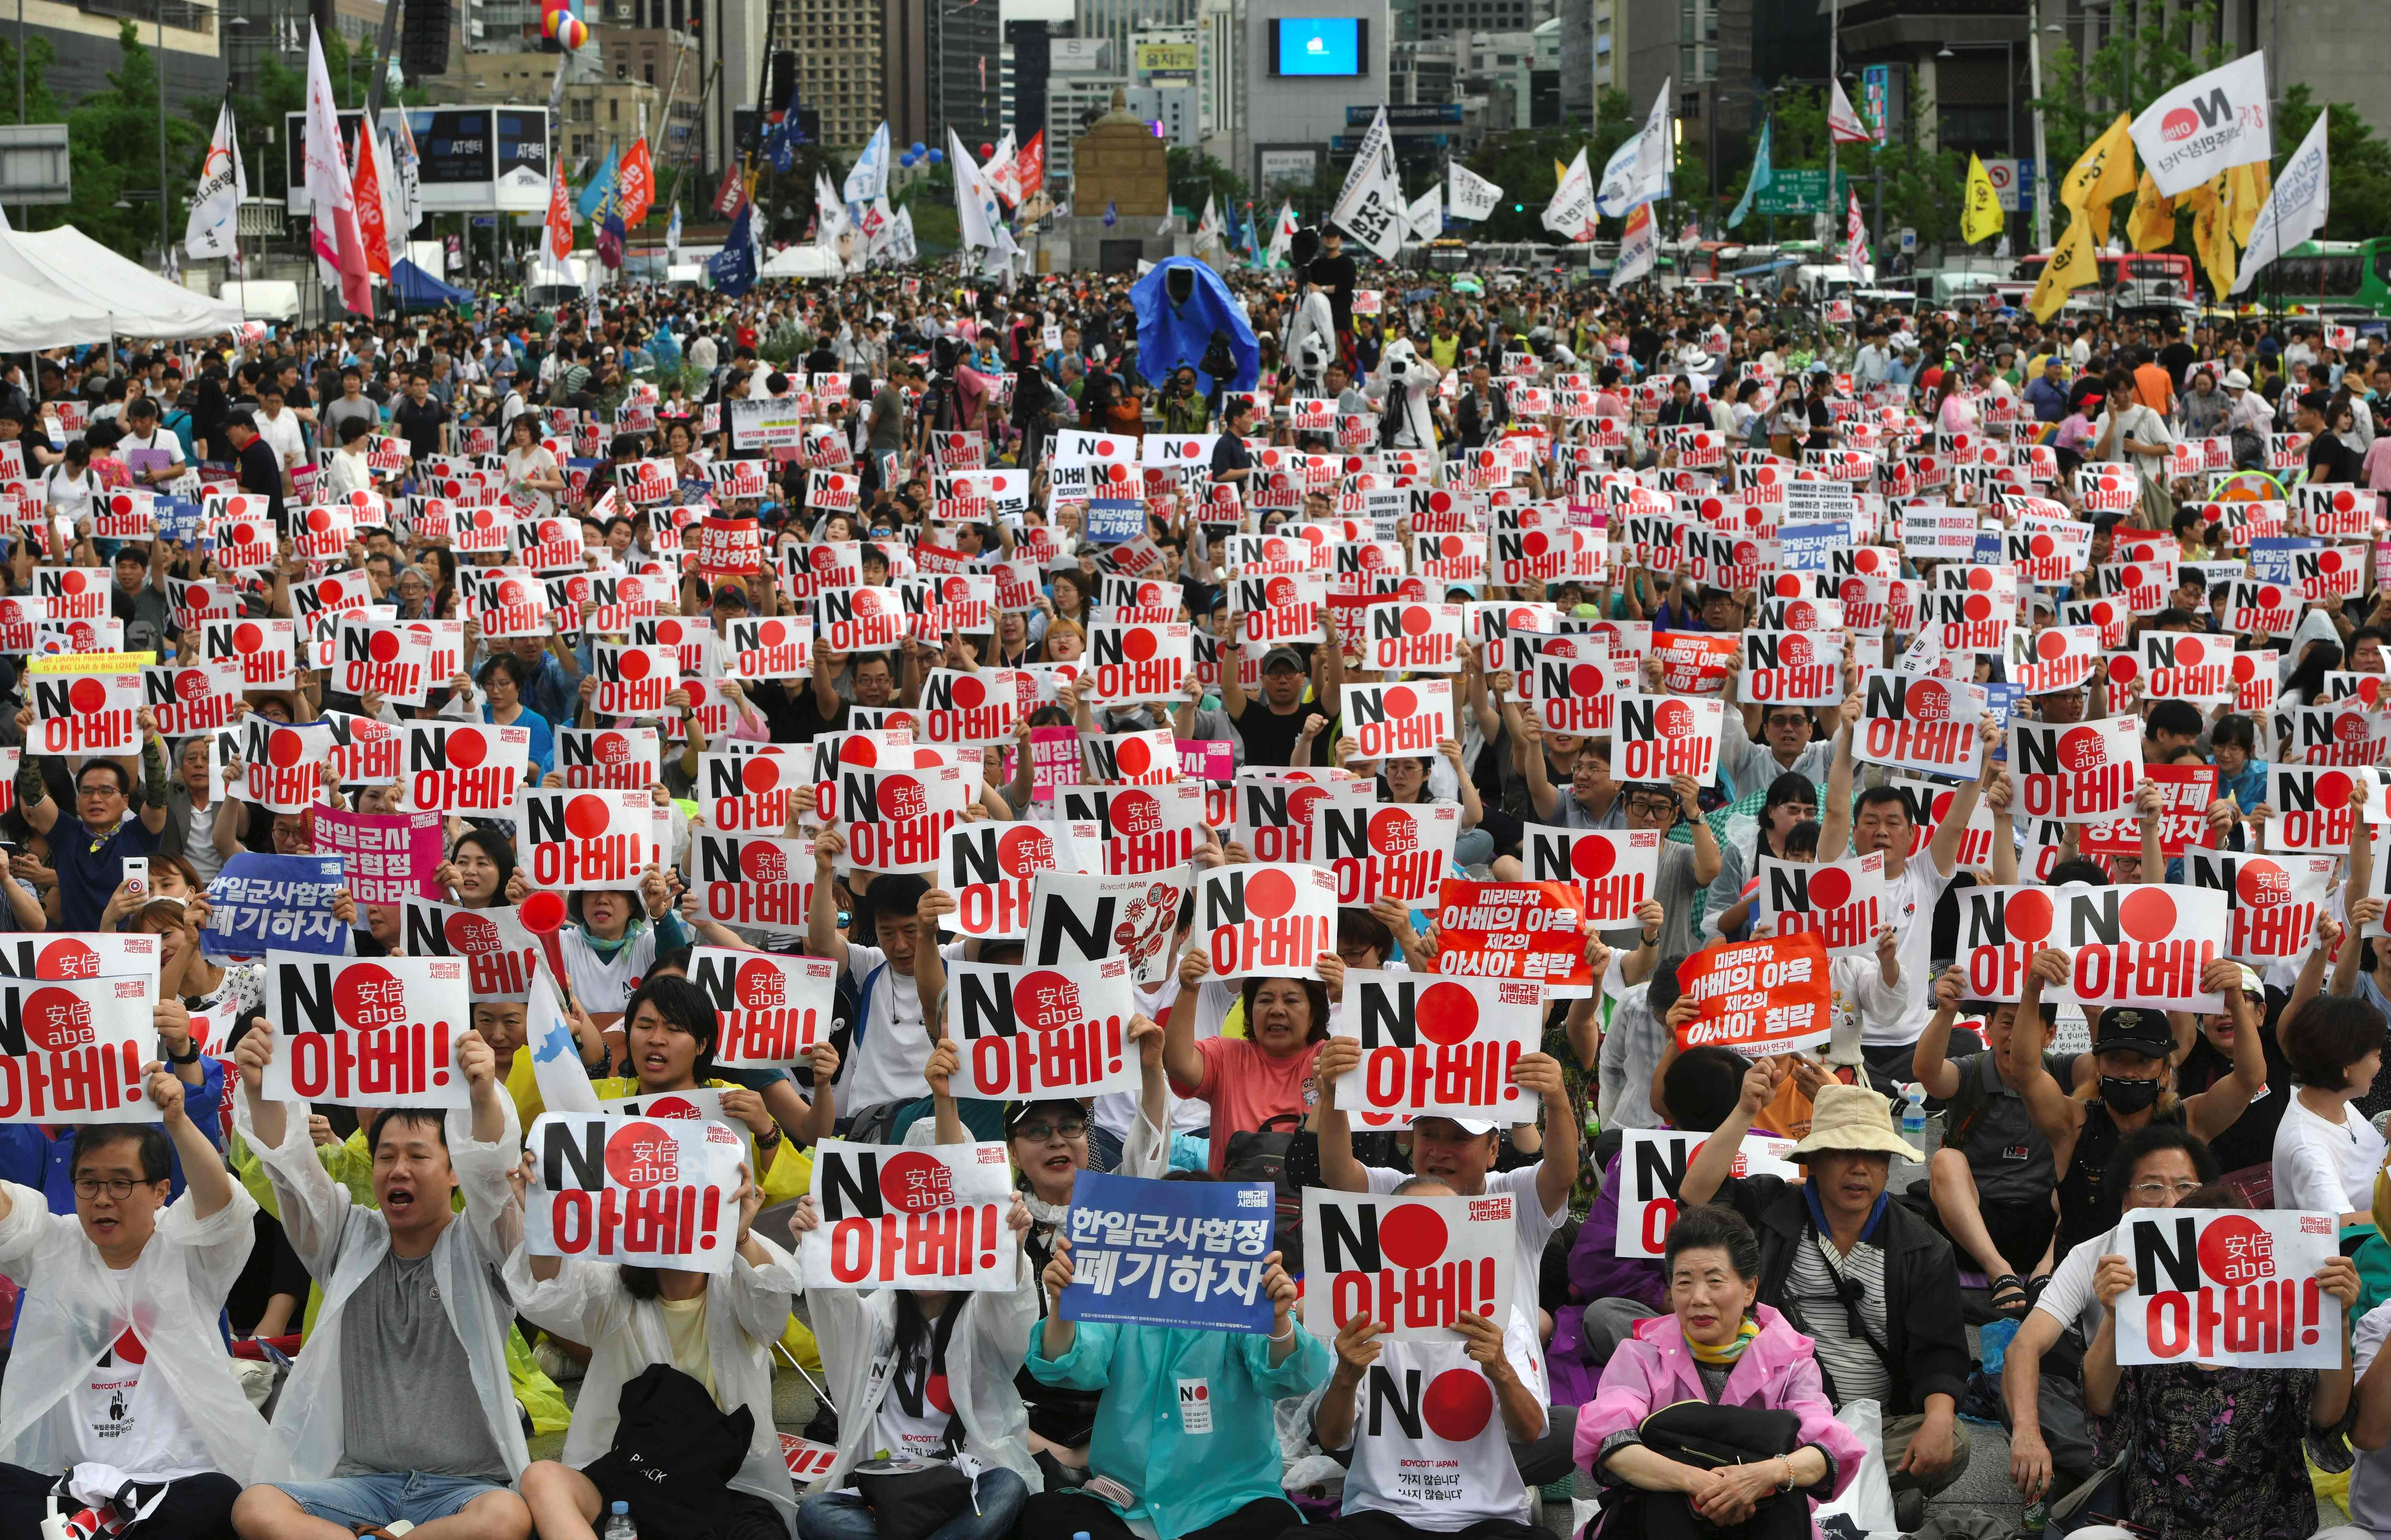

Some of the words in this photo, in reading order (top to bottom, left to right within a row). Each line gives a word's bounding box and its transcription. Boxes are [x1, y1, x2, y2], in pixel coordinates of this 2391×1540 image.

[1939, 518, 1974, 529] 사죄하고
[701, 527, 759, 549] 친일적폐
[700, 546, 761, 567] 청산하자
[1673, 639, 1708, 651] 미리막자
[315, 816, 411, 850] 한일군사
[1127, 881, 1147, 890] JAPAN
[1479, 890, 1540, 905] 미리막자
[1443, 906, 1519, 931] 아베의
[1526, 907, 1577, 932] 야욕
[1484, 933, 1530, 950] 제2의
[430, 963, 460, 971] 아베규탄
[1441, 951, 1517, 976] 아시아
[1524, 952, 1575, 979] 침략
[1715, 945, 1773, 969] 미리막자
[430, 971, 460, 979] 시민행동
[1690, 966, 1753, 1002] 아베의
[1762, 958, 1811, 987] 야욕
[357, 978, 404, 1003] 安倍
[1037, 982, 1079, 1007] 安倍
[1725, 991, 1768, 1011] 제2의
[46, 1001, 90, 1027] 安倍
[358, 1004, 406, 1024] abe
[1039, 1005, 1082, 1025] abe
[1688, 1014, 1757, 1045] 아시아
[1765, 1003, 1814, 1032] 침략
[48, 1026, 95, 1045] abe
[1740, 1044, 1769, 1054] 근현대사
[1772, 1040, 1793, 1051] 연구회
[633, 1139, 679, 1162] 安倍
[629, 1162, 679, 1182] abe
[906, 1166, 952, 1189] 安倍
[907, 1189, 955, 1206] abe
[1238, 1191, 1268, 1200] 아베규탄
[1238, 1199, 1268, 1207] 시민행동
[1469, 1199, 1512, 1210] 아베규탄
[1469, 1208, 1512, 1220] 시민행동
[2299, 1216, 2331, 1225] 아베규탄
[1071, 1207, 1270, 1256] 한일군사협정
[2299, 1224, 2331, 1234] 시민행동
[2225, 1234, 2273, 1256] 安倍
[2225, 1257, 2276, 1278] abe
[1072, 1250, 1268, 1306] 폐기하자
[902, 1435, 938, 1443] BOYCOTT
